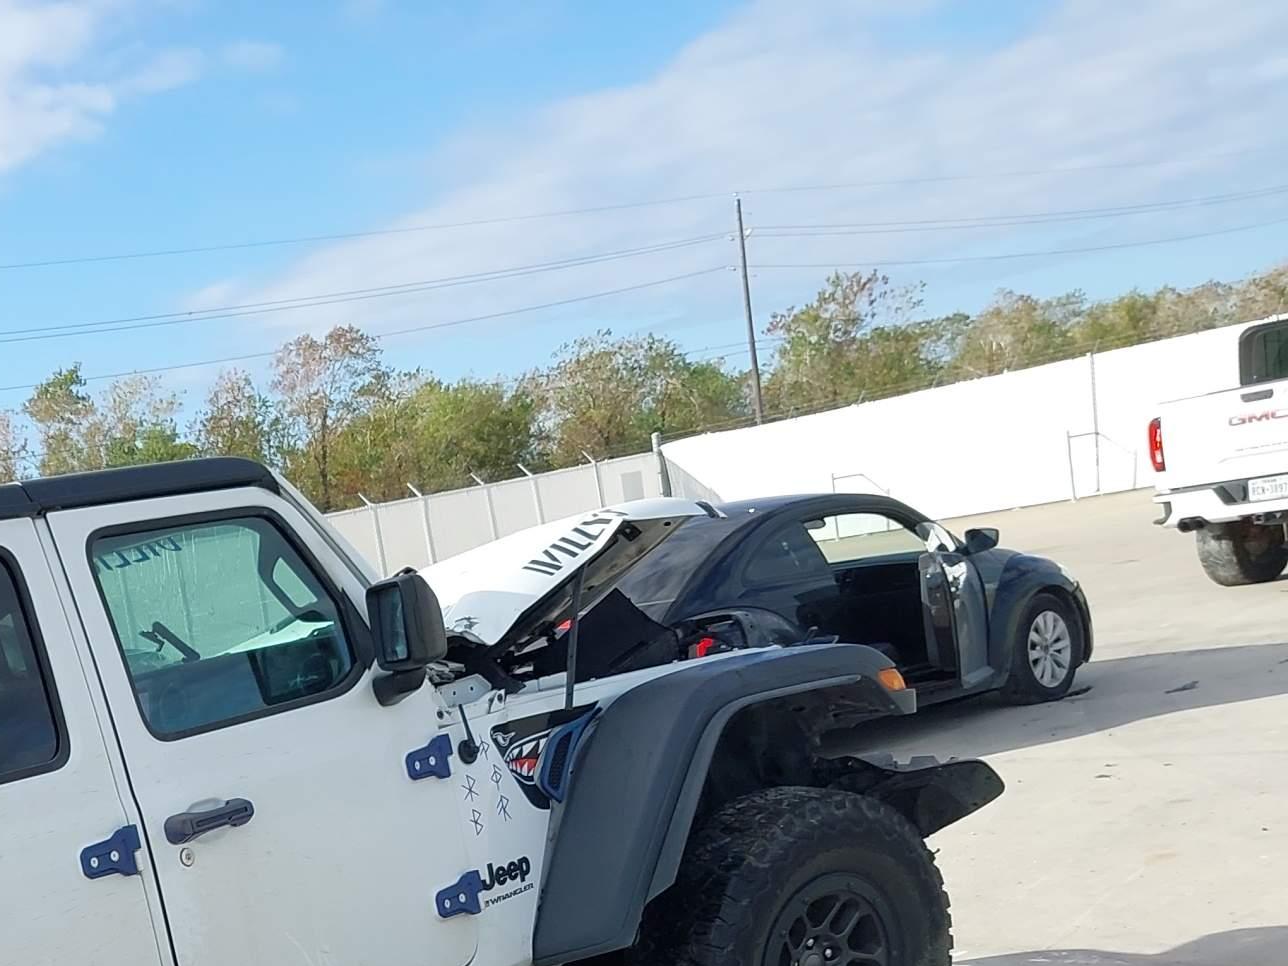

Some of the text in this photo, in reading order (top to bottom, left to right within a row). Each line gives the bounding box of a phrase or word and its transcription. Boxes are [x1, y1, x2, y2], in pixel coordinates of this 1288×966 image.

[1228, 408, 1288, 426] GMC
[480, 856, 531, 891] Jeep
[489, 882, 534, 905] WRANGLER
